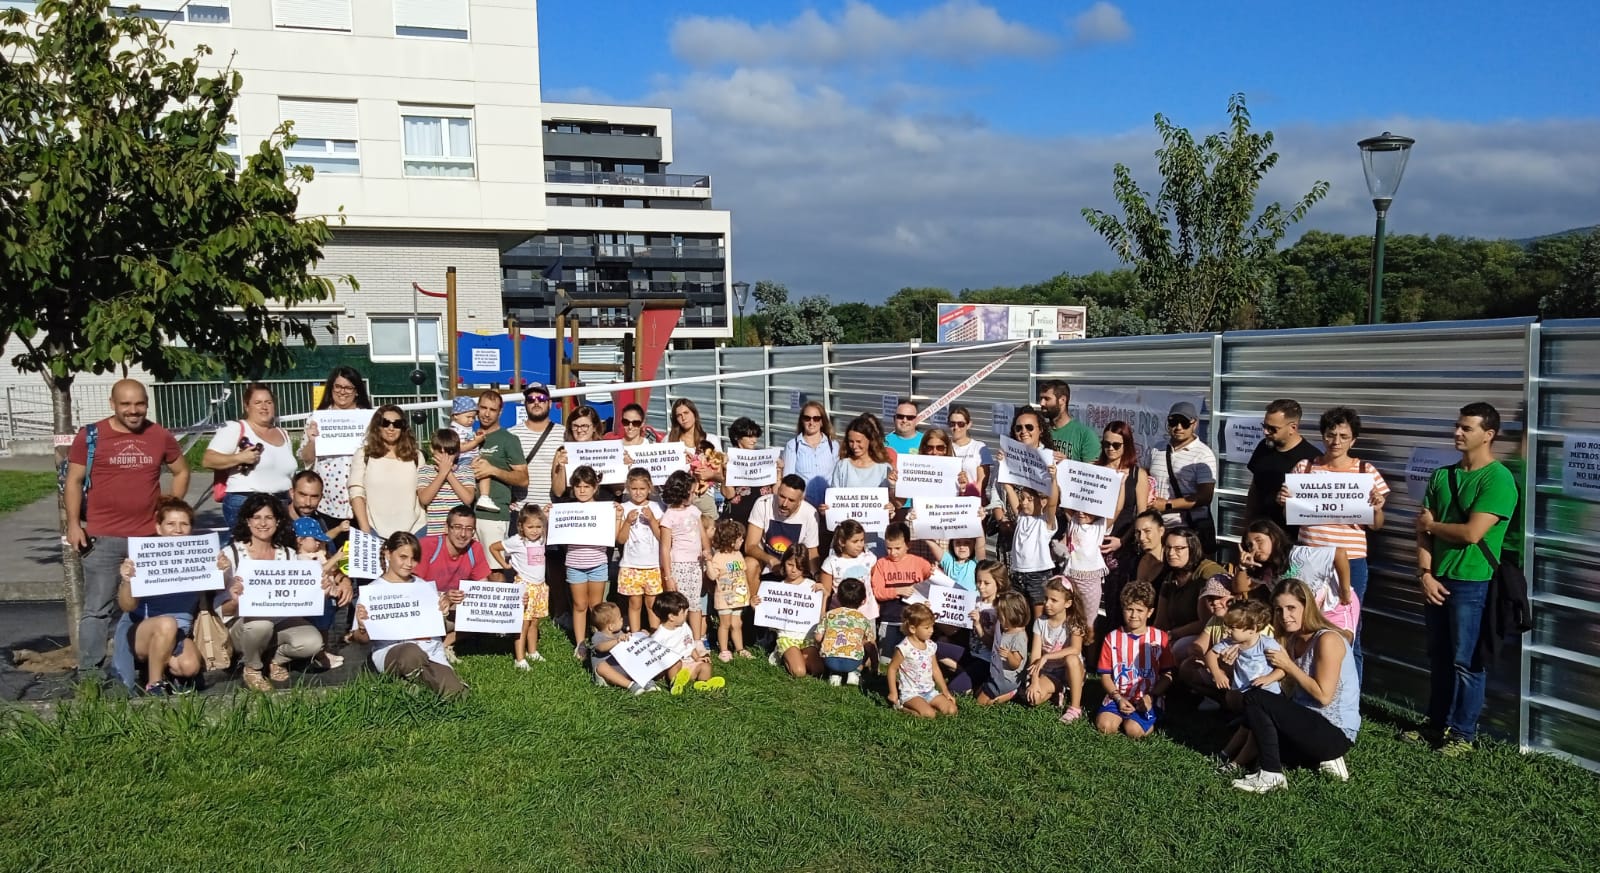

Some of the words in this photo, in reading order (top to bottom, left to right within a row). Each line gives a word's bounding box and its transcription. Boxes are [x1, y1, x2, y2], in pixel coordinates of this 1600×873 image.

[1138, 410, 1159, 436] NO
[1570, 452, 1599, 460] METROS
[883, 572, 916, 581] LOADING
[370, 602, 410, 611] SEGURIDAD
[371, 612, 408, 620] CHAPUZAS
